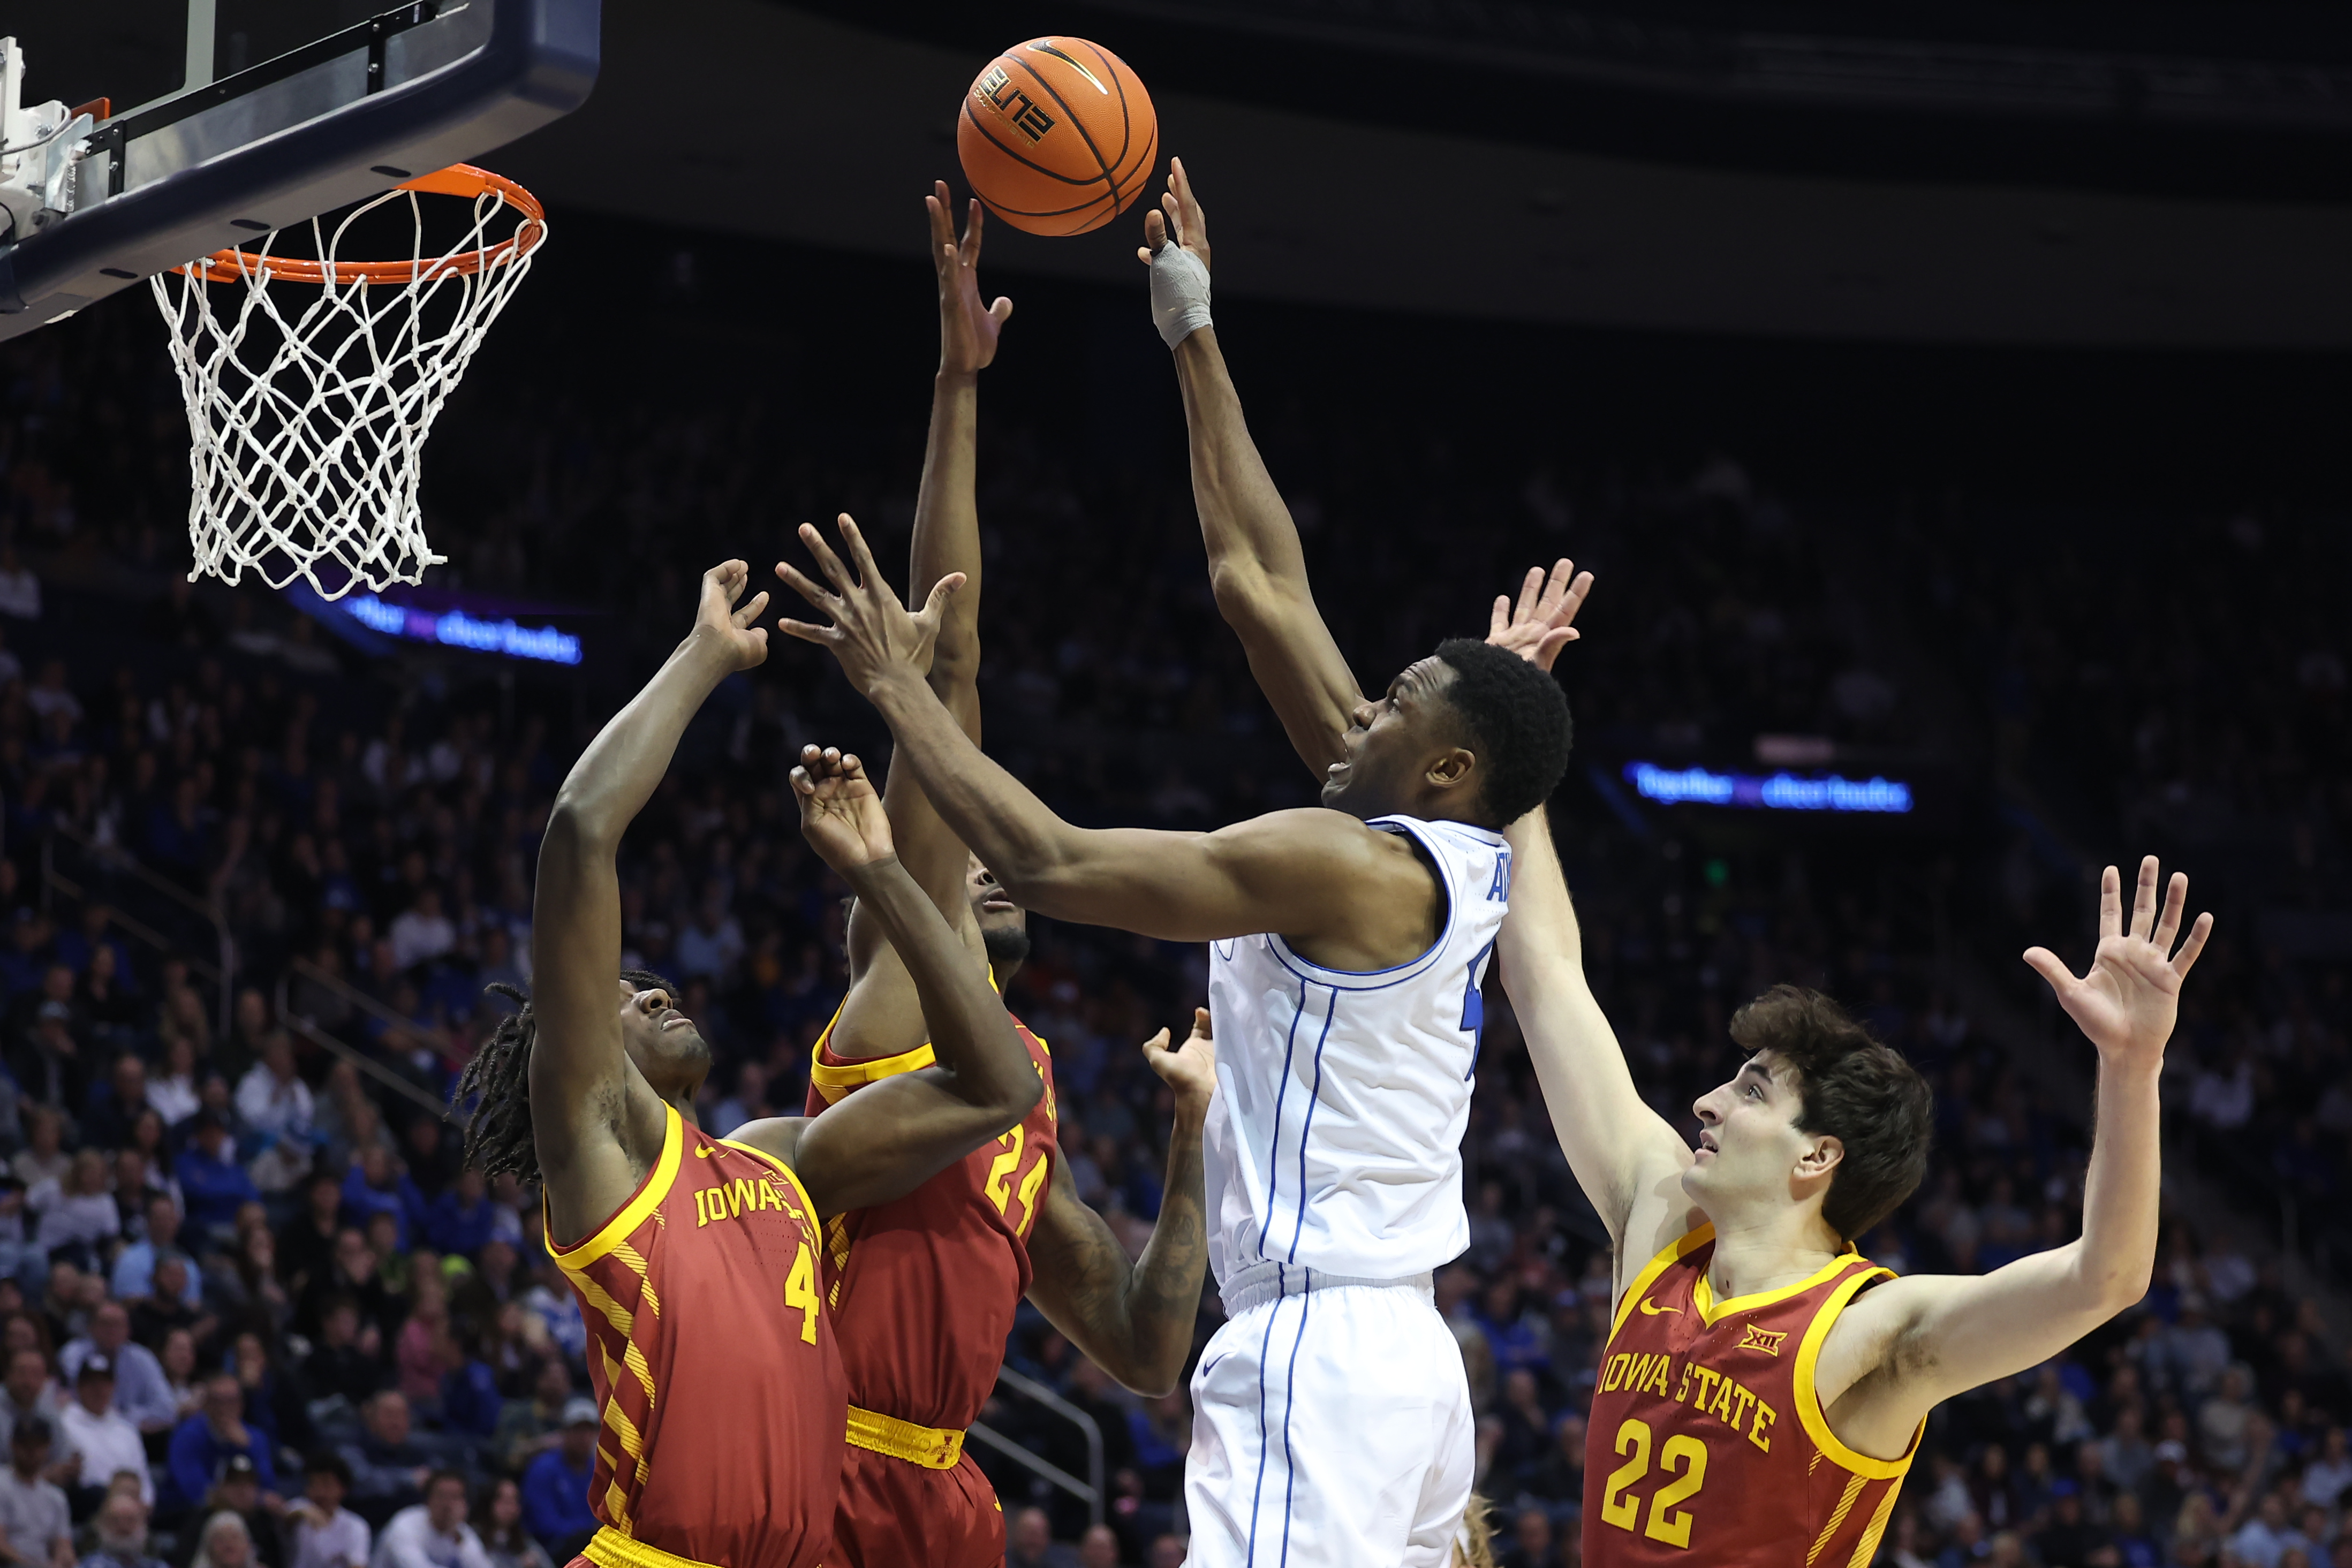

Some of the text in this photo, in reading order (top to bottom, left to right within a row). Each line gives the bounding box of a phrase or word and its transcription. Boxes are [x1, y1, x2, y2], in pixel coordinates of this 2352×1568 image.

[978, 65, 1056, 144] ELITE
[693, 1178, 783, 1228] IOWA
[984, 1123, 1048, 1238] 24
[785, 1240, 820, 1346] 4
[1598, 1352, 1778, 1454] IOWA STATE
[1601, 1418, 1709, 1550] 22
